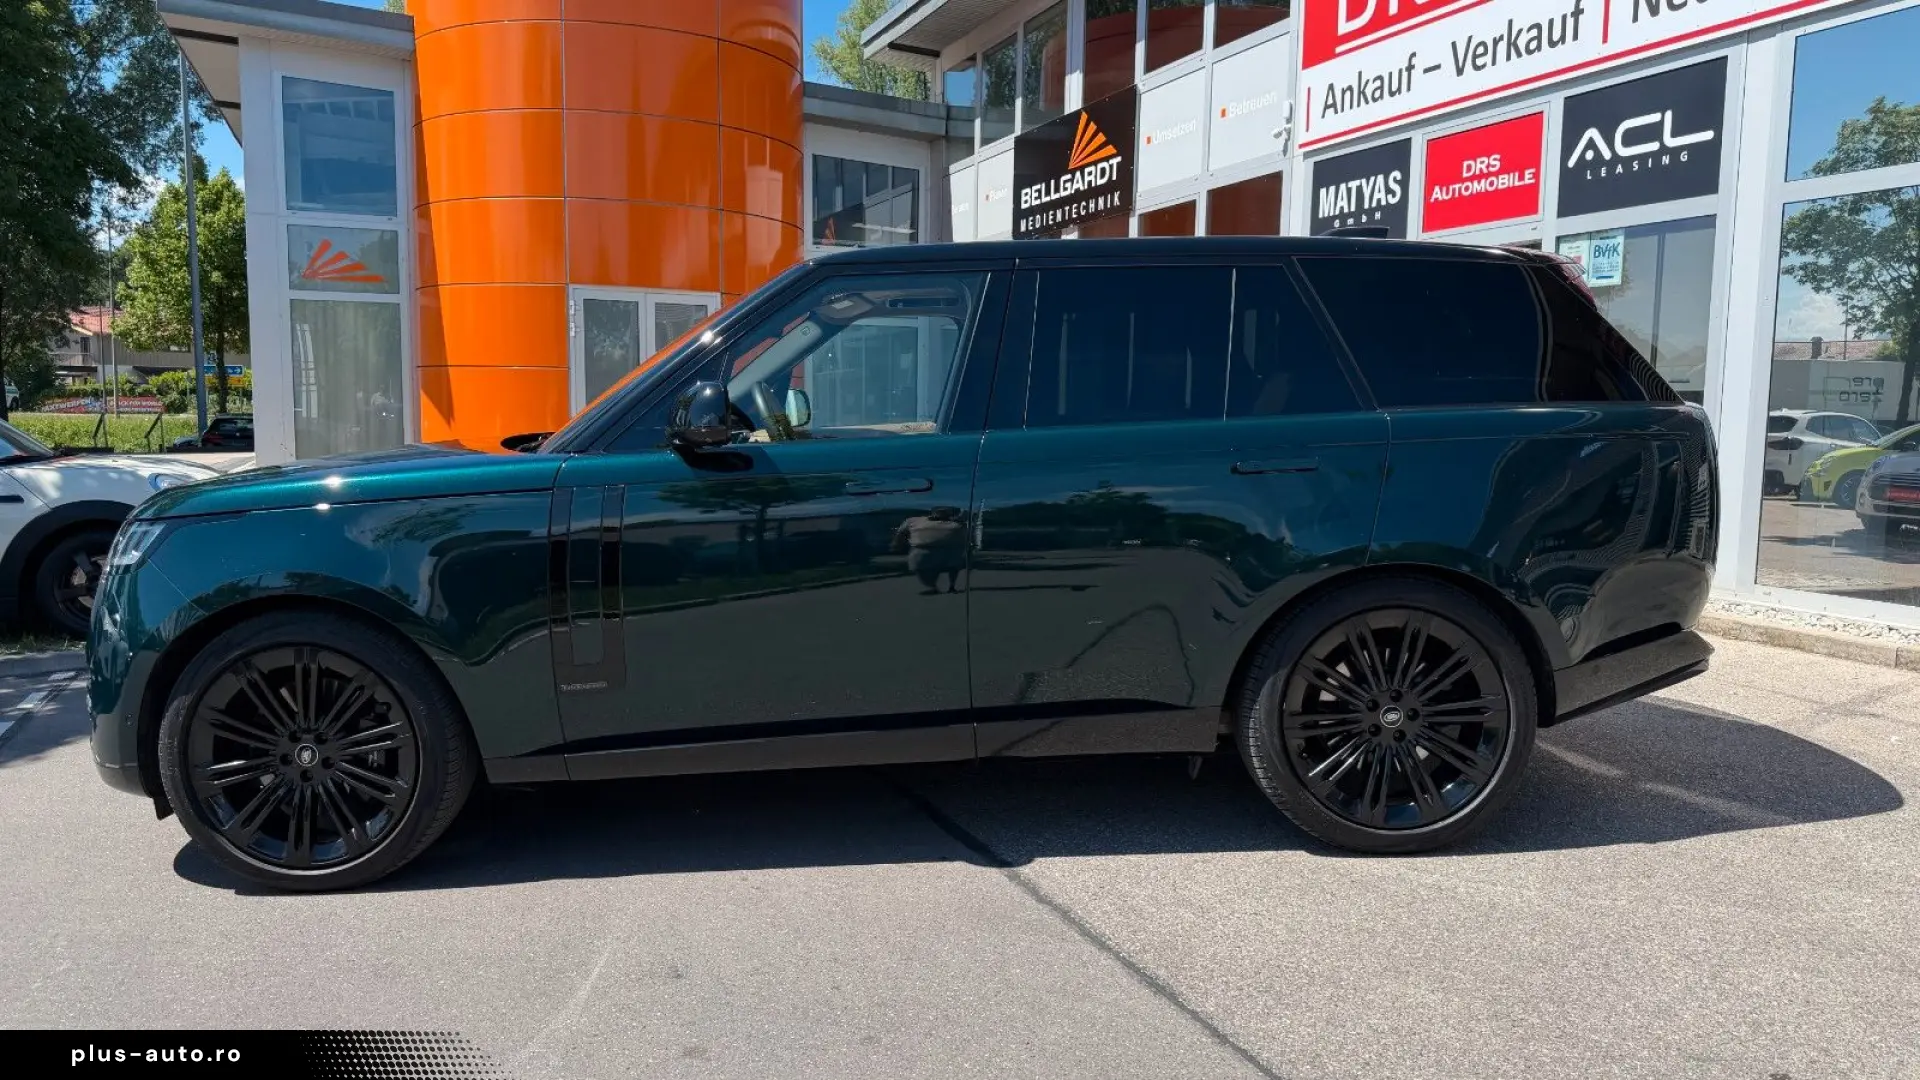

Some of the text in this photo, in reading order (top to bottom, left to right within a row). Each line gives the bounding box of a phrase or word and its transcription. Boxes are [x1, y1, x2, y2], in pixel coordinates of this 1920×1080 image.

[1321, 52, 1416, 119] Ankauf
[1451, 0, 1585, 78] Verkauf
[1568, 110, 1714, 168] ACL
[1020, 156, 1122, 210] BELLGARDT
[1430, 168, 1536, 203] AUTOMOBILE
[1461, 154, 1501, 178] DRS
[1586, 151, 1688, 180] LEASING
[1020, 191, 1121, 233] MEDIENTECHNIK
[1318, 170, 1402, 218] MATYAS
[1333, 211, 1381, 228] GmbH
